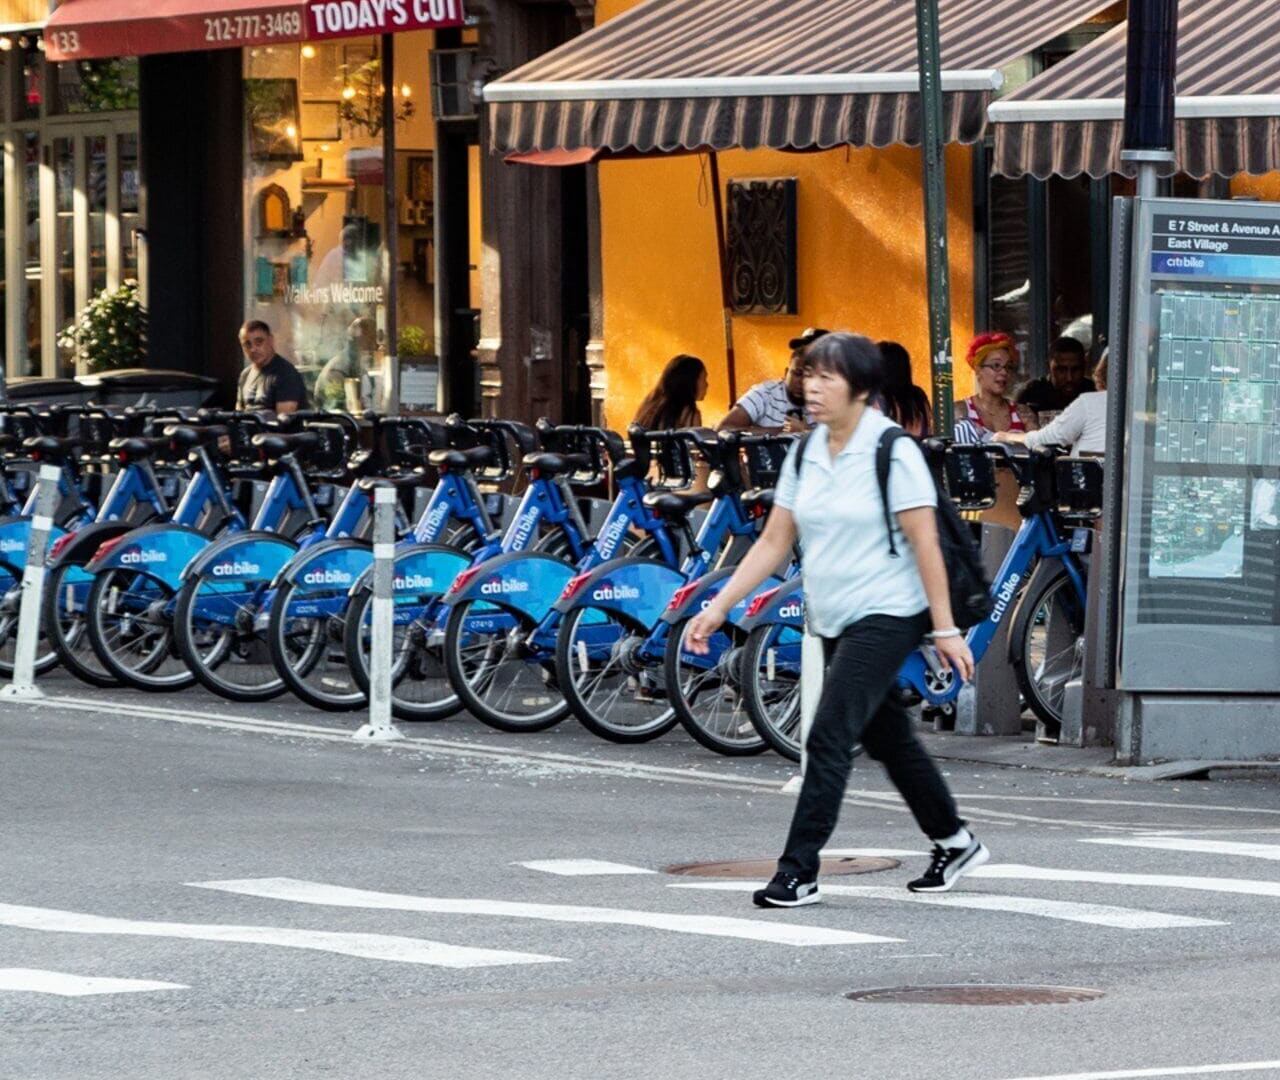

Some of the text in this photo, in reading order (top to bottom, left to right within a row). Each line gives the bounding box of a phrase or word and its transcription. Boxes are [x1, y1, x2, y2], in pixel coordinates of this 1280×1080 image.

[204, 12, 300, 42] 212-777-3469
[50, 30, 79, 54] 133
[1168, 220, 1280, 235] E 7 Street & Avenue A
[1167, 237, 1229, 252] East Village
[330, 282, 384, 304] Welcome
[611, 513, 629, 539] bike
[392, 576, 404, 589] iti
[1001, 572, 1020, 602] bike
